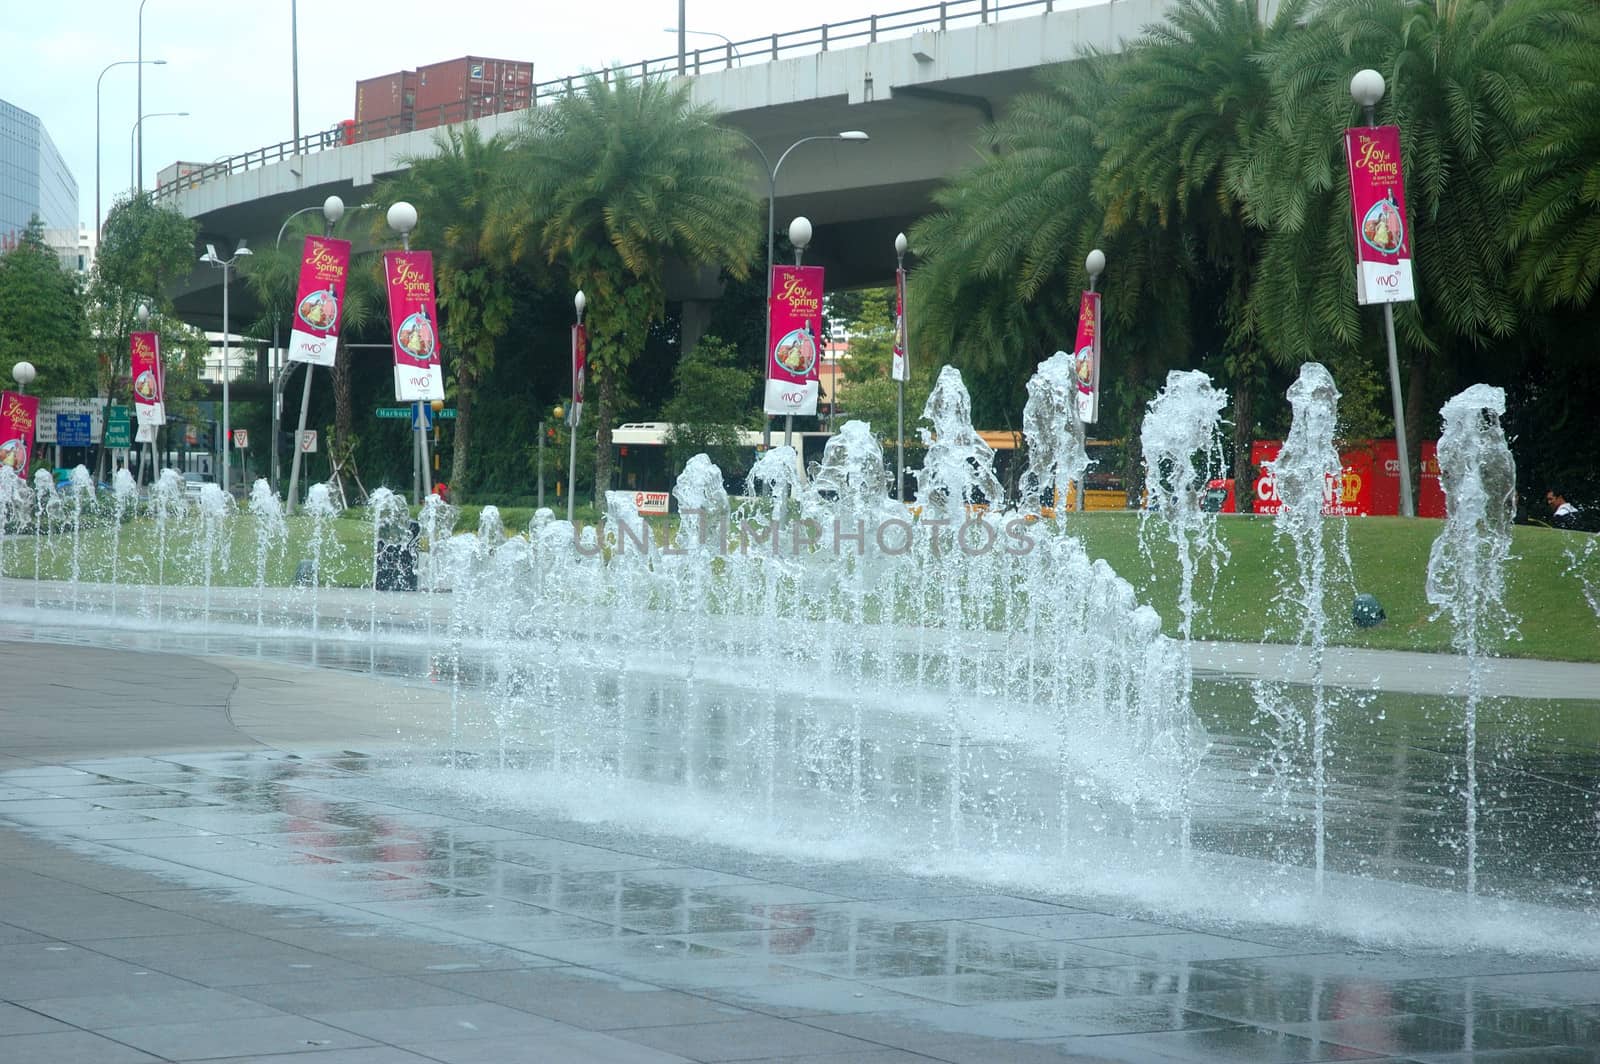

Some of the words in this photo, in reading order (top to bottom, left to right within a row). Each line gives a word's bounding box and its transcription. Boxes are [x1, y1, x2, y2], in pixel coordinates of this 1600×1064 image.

[1358, 135, 1371, 144] The
[1355, 140, 1384, 168] Joy
[1367, 160, 1398, 176] Spring
[305, 247, 333, 265] Joy
[395, 257, 406, 265] The
[315, 260, 344, 276] Spring
[392, 262, 418, 286] Joy
[783, 271, 795, 281] The
[403, 279, 431, 294] Spring
[776, 278, 807, 301] Joy
[789, 295, 818, 310] Spring
[300, 342, 322, 353] VIVO
[409, 376, 430, 388] VIVO
[3, 402, 27, 418] Joy
[11, 414, 33, 427] Spring
